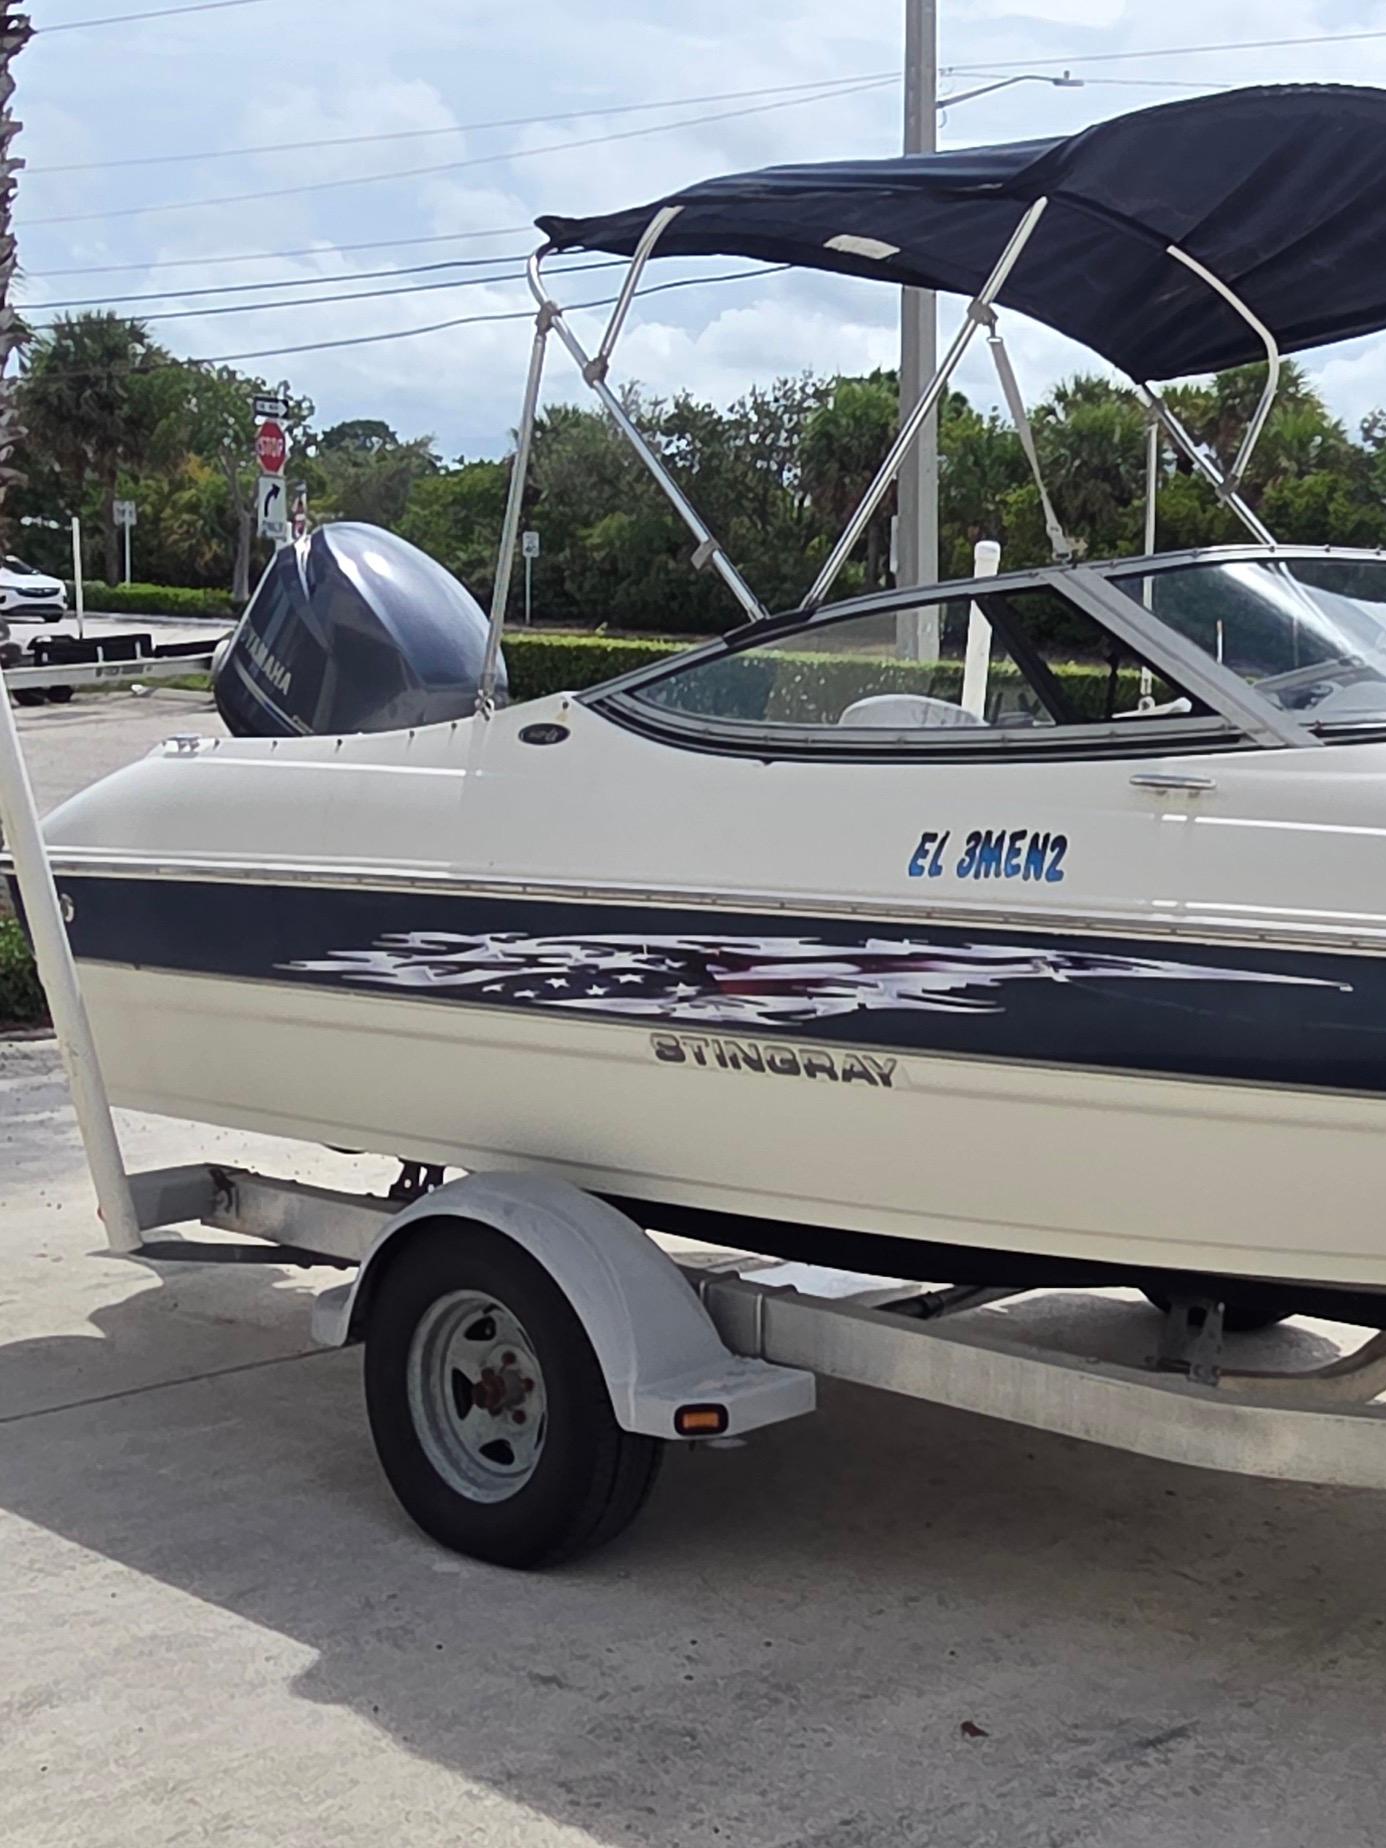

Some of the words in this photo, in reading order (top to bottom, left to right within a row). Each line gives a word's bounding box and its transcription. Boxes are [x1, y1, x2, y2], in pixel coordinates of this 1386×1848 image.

[256, 436, 283, 458] STOP
[908, 829, 951, 878] EL
[956, 829, 1068, 883] 3MEN2
[650, 1032, 897, 1088] STINGRAY
